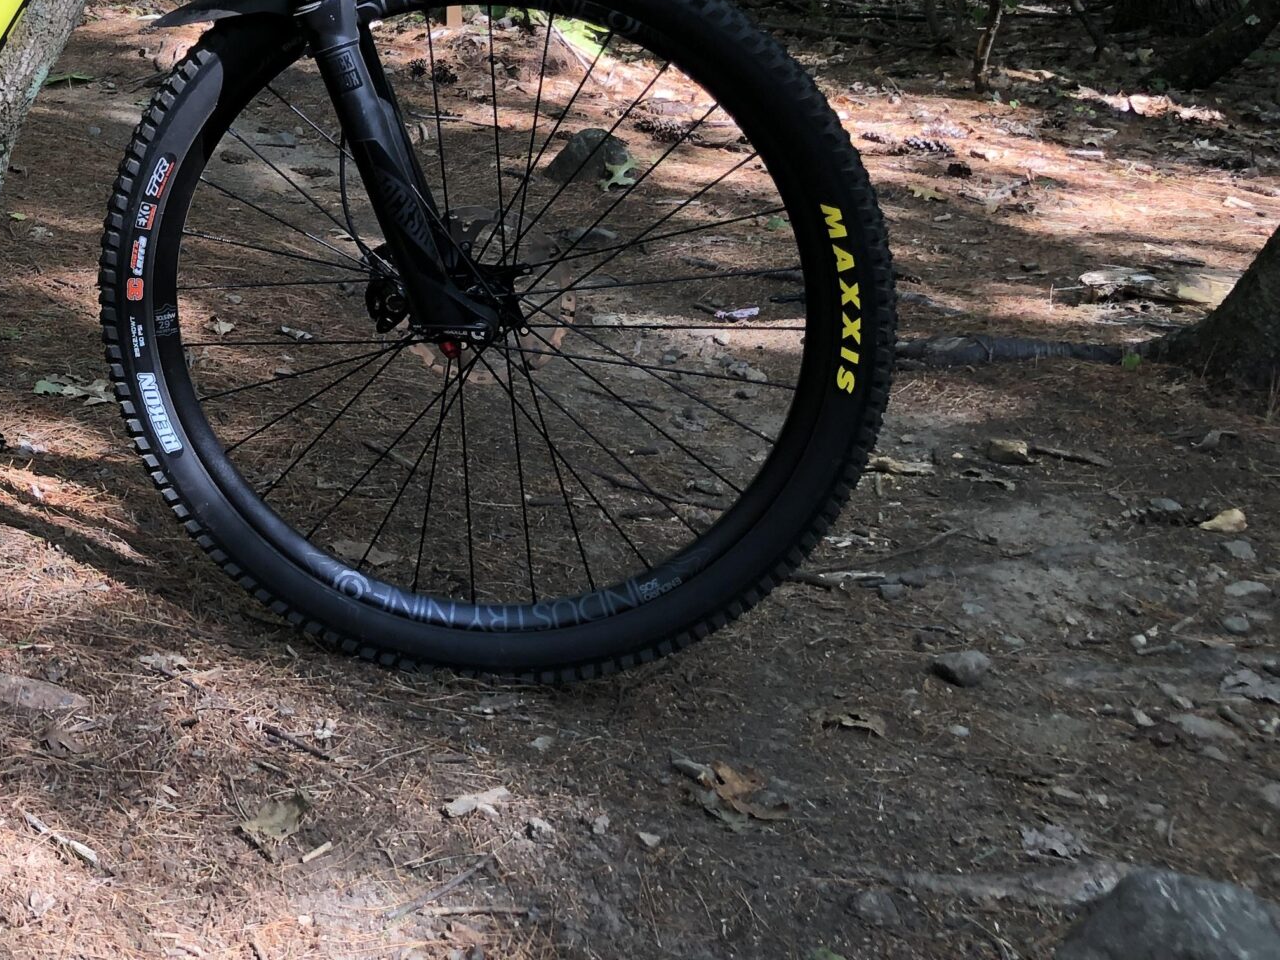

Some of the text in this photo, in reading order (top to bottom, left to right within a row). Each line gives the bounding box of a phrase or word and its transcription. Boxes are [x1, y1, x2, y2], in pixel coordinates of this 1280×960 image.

[145, 156, 169, 198] TR
[136, 202, 152, 228] EXO
[820, 204, 861, 394] MAXXIS
[137, 372, 183, 455] REKON
[373, 578, 640, 632] INDUSTRY NINE
